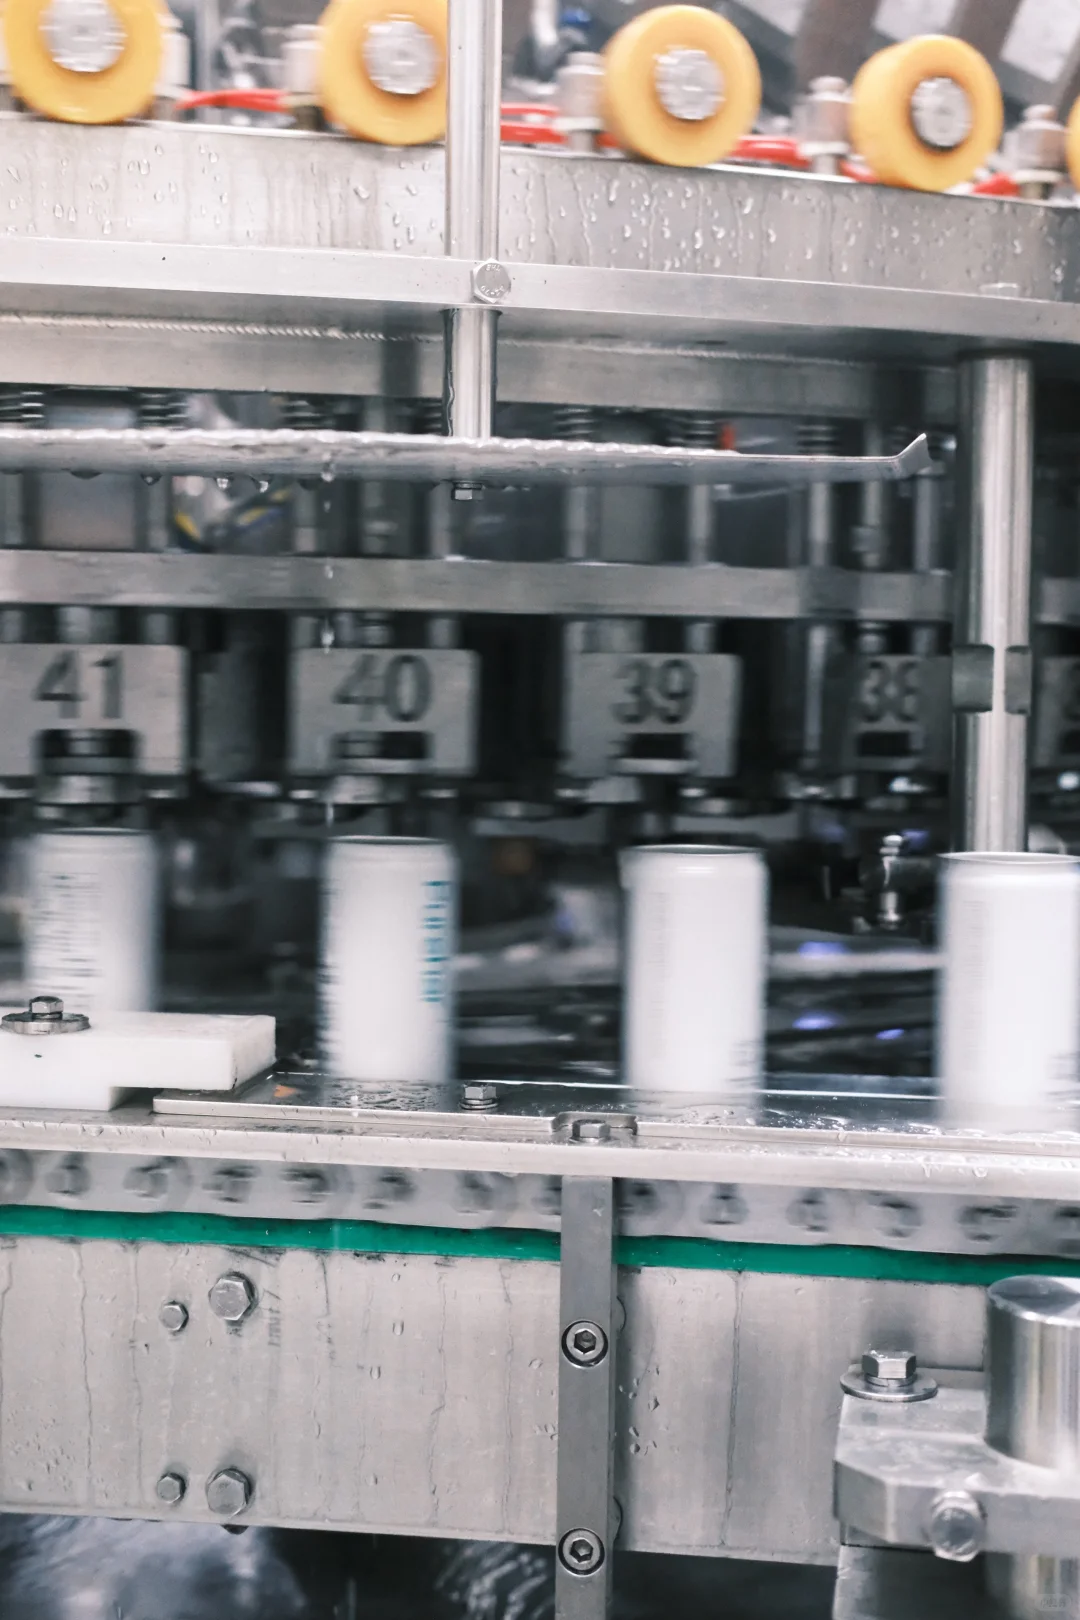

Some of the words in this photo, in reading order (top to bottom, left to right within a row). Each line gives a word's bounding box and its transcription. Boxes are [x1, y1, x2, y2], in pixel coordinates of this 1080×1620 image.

[34, 649, 124, 720] 41
[332, 652, 432, 723] 40
[611, 658, 697, 724] 39
